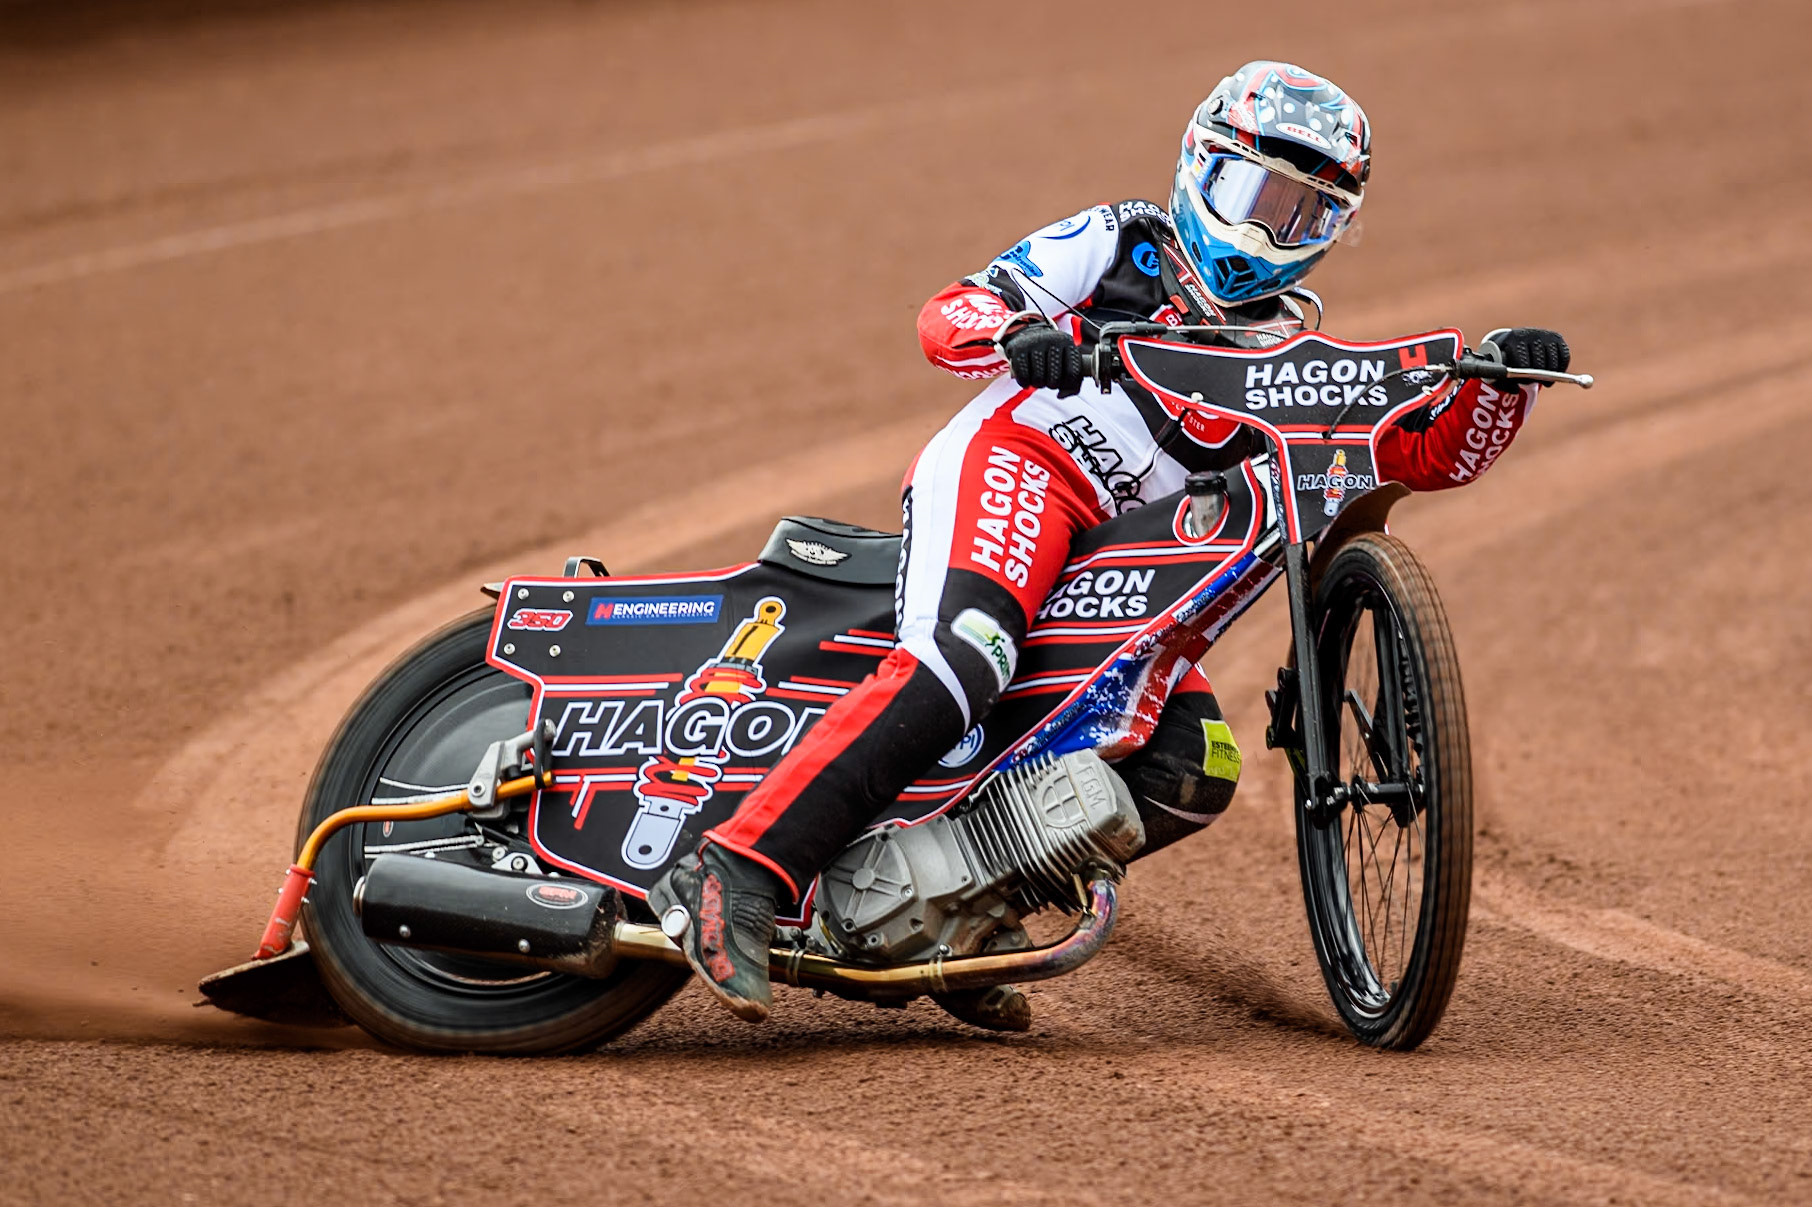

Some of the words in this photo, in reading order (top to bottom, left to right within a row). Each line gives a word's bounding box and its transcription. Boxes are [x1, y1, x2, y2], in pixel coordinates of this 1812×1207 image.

[1287, 125, 1323, 144] BELL
[1245, 359, 1386, 389] HAGON
[1245, 385, 1389, 411] SHOCKS
[1448, 382, 1500, 482] HAGON
[1297, 473, 1376, 491] HAGON
[971, 446, 1021, 573] HAGON
[1004, 459, 1051, 588] SHOCKS
[612, 601, 715, 616] ENGINEERING
